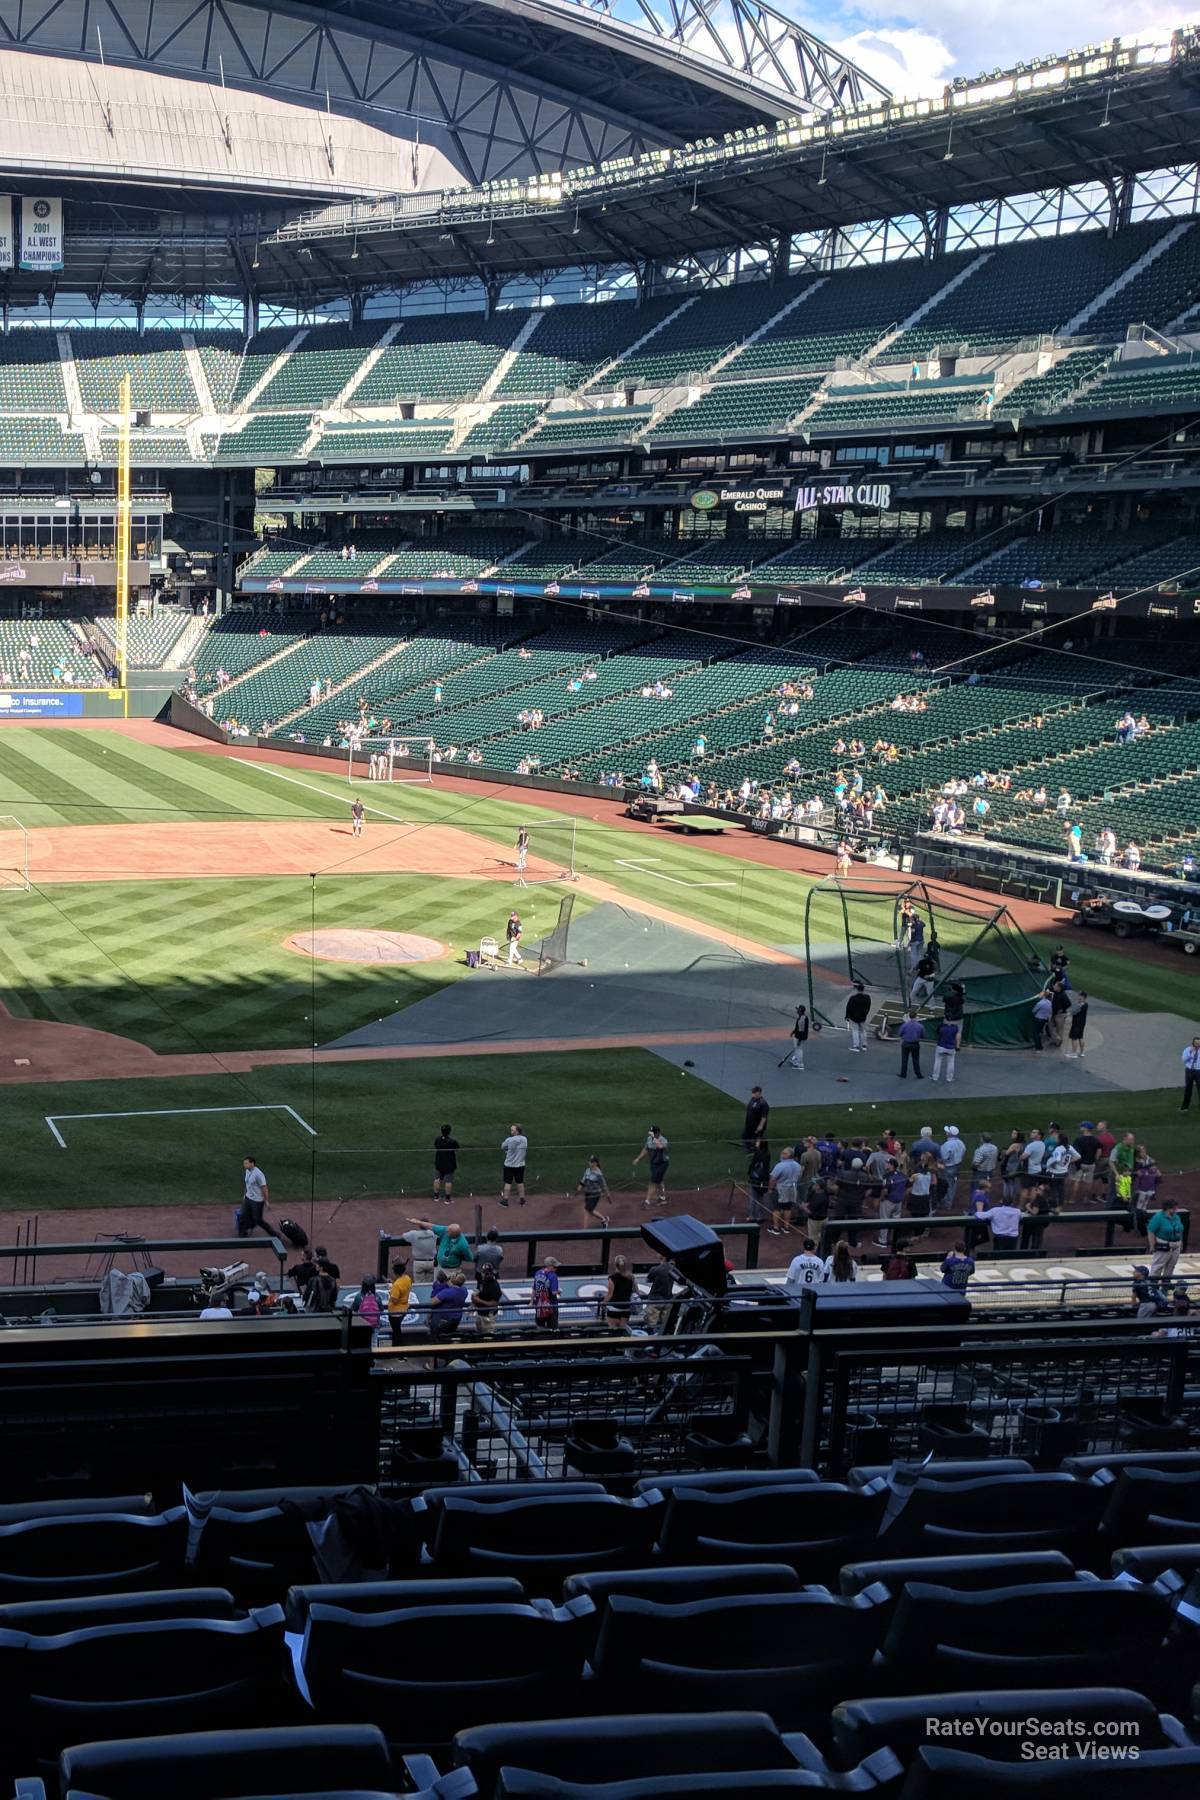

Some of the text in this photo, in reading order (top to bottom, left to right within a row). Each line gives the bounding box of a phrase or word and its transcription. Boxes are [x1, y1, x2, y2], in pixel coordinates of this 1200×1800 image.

[33, 223, 50, 233] 2001
[27, 237, 56, 247] A.L. WEST
[23, 250, 60, 261] CHAMPIONS
[720, 488, 784, 500] EMERALD QUEEN
[795, 485, 891, 512] ALL STAR CLUB
[735, 501, 767, 511] CASINOS
[805, 1270, 813, 1283] 6
